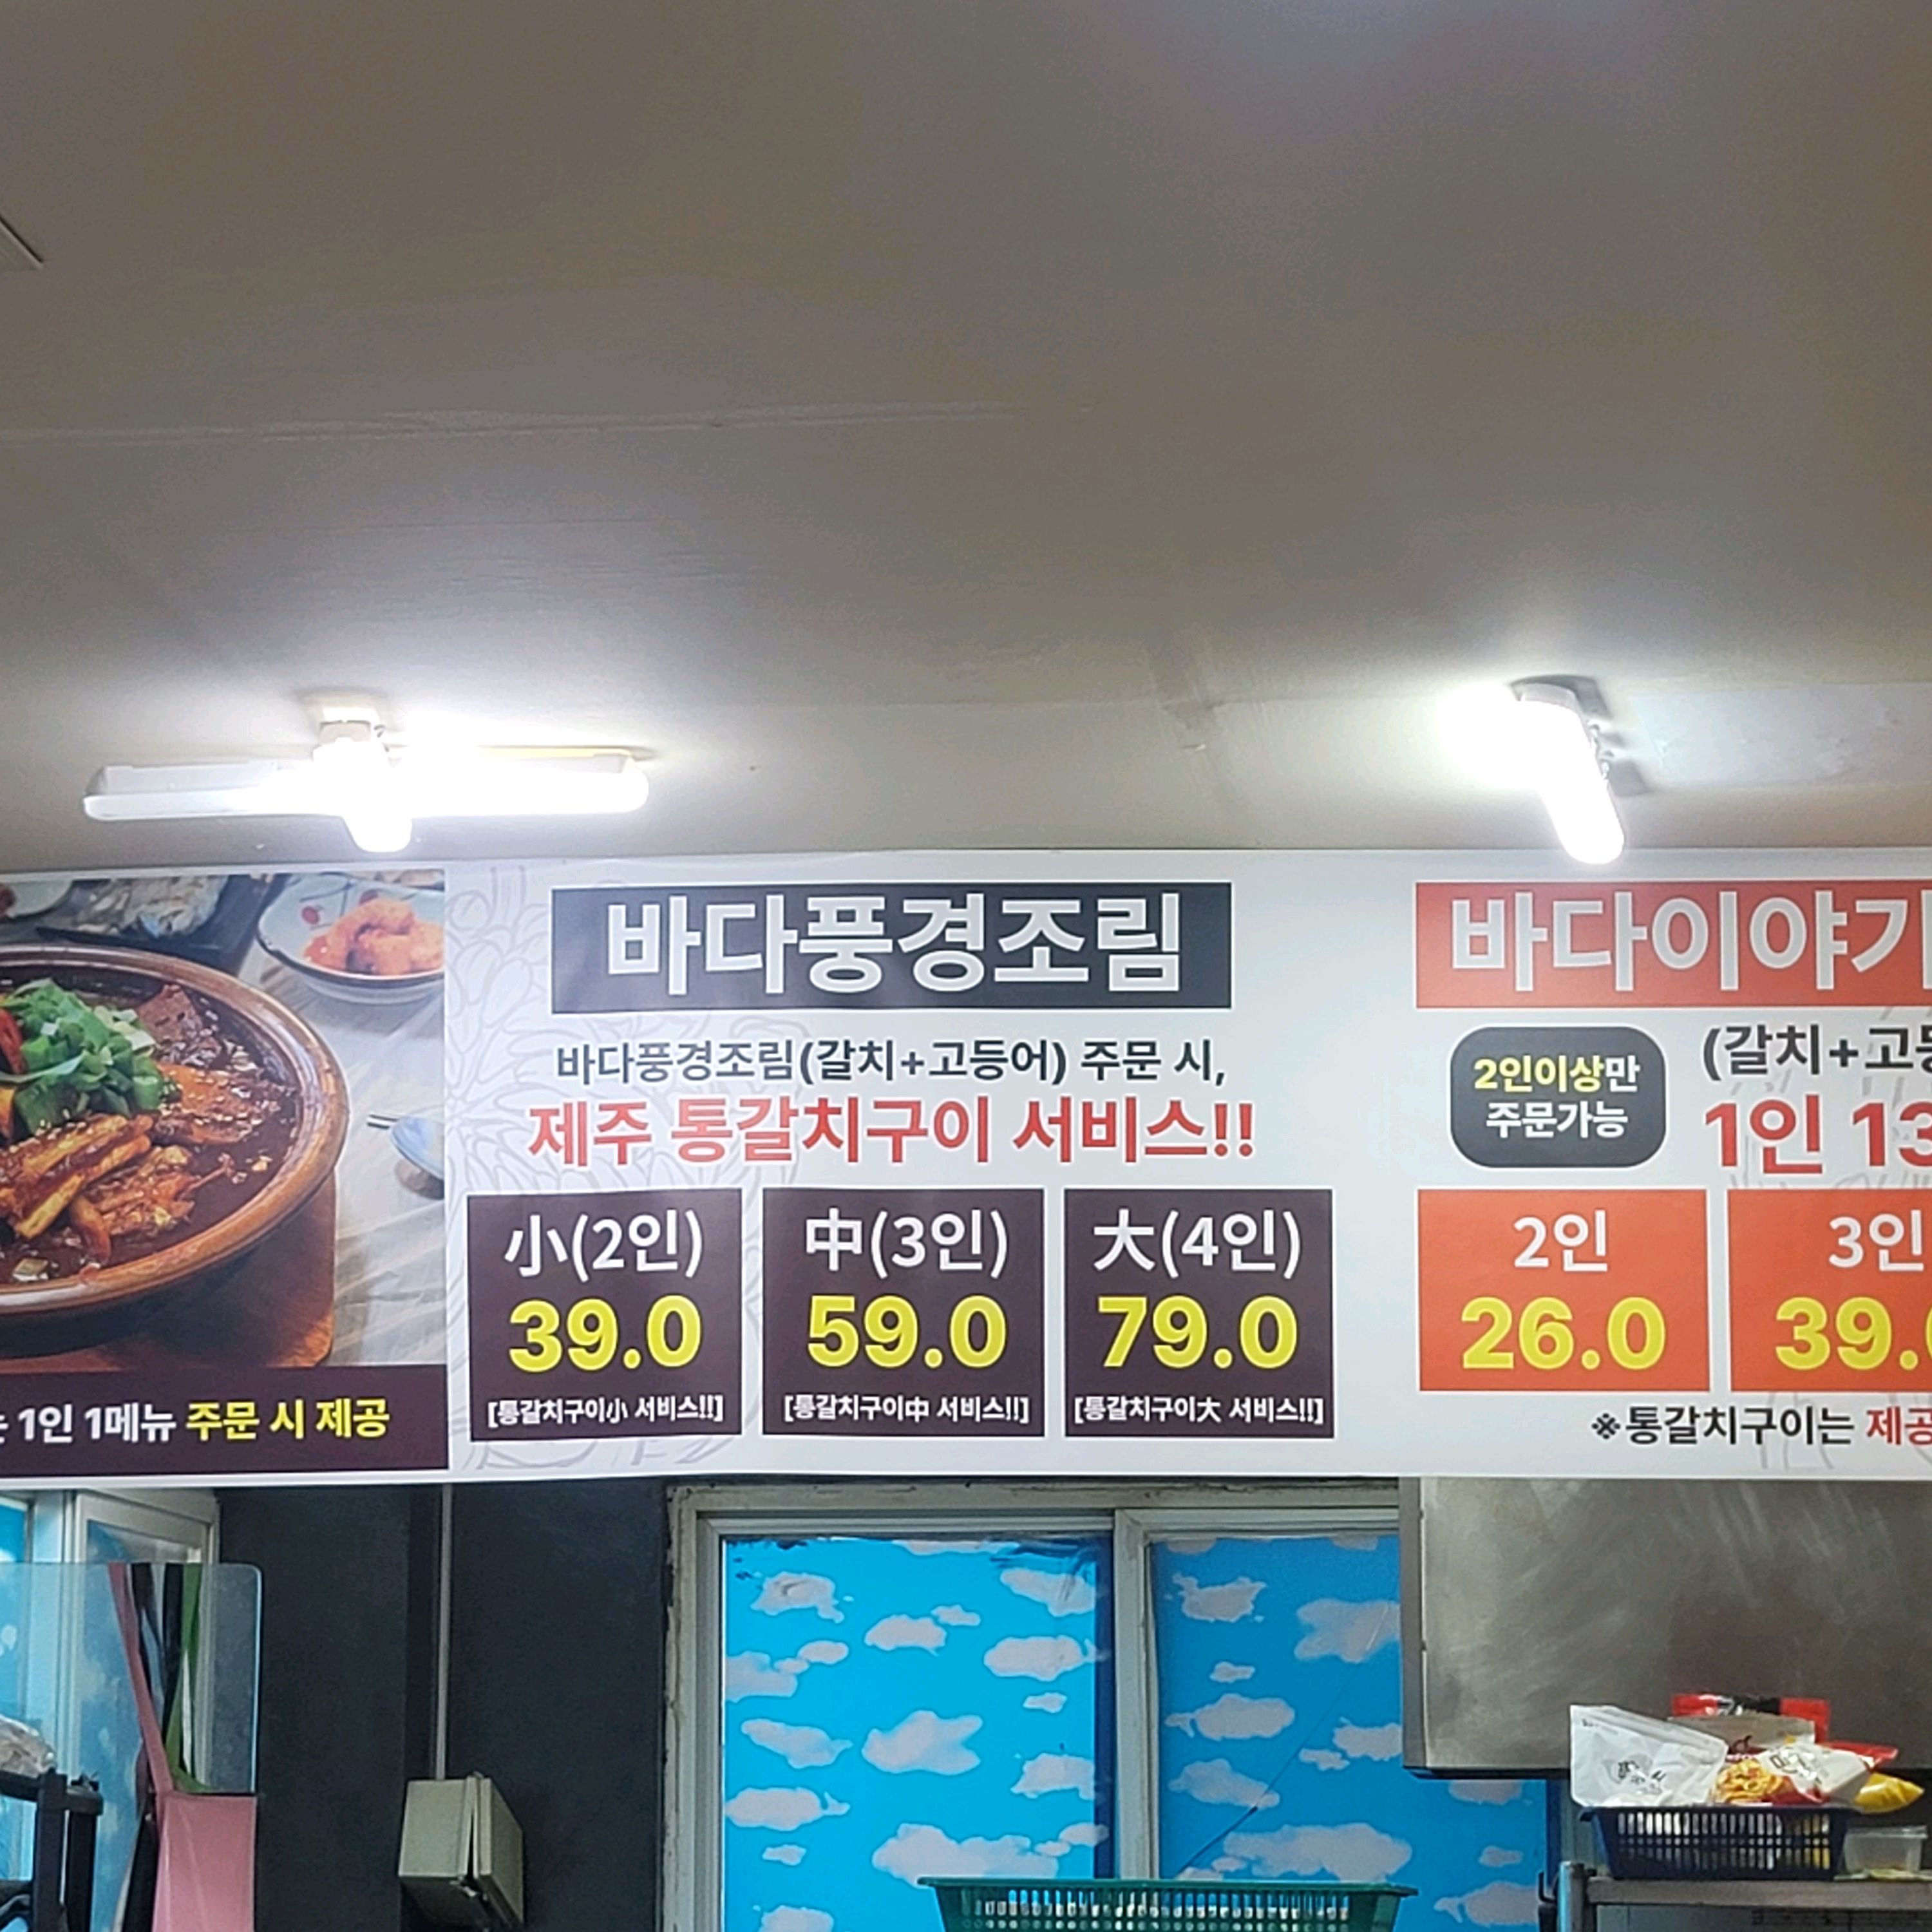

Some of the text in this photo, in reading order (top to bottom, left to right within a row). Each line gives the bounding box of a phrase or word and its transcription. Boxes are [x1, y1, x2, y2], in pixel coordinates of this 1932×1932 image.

[607, 892, 1181, 994] 바다풍경조림
[1452, 890, 1932, 991] 바다이야기
[556, 1037, 1225, 1086] 바다풍경조림(갈치+고등어) 주문 시,
[1474, 1056, 1640, 1094] 2인이상만
[529, 1096, 1253, 1166] 제주 통갈치구이 서비스!!
[1486, 1101, 1629, 1139] 주문가능
[1705, 1094, 1823, 1174] 1인
[504, 1208, 703, 1282] 小(2인)
[805, 1207, 1009, 1280] 中(3인)
[1093, 1208, 1302, 1280] 大(4인)
[1513, 1209, 1609, 1273] 2인
[1828, 1209, 1924, 1272] 3인
[508, 1294, 701, 1372] 39.0
[806, 1294, 1007, 1368] 59.0
[1097, 1295, 1297, 1369] 79.0
[1461, 1296, 1666, 1370] 26.0
[1775, 1296, 1932, 1370] 39.
[18, 1404, 73, 1443] 1인
[84, 1403, 177, 1442] 1메뉴
[186, 1401, 260, 1441] 주문
[269, 1399, 304, 1439] 시
[316, 1398, 390, 1439] 제공
[634, 1394, 724, 1423] 서비스!!]
[936, 1395, 1030, 1424] 서비스!!]
[1229, 1396, 1324, 1425] 서비스!!]
